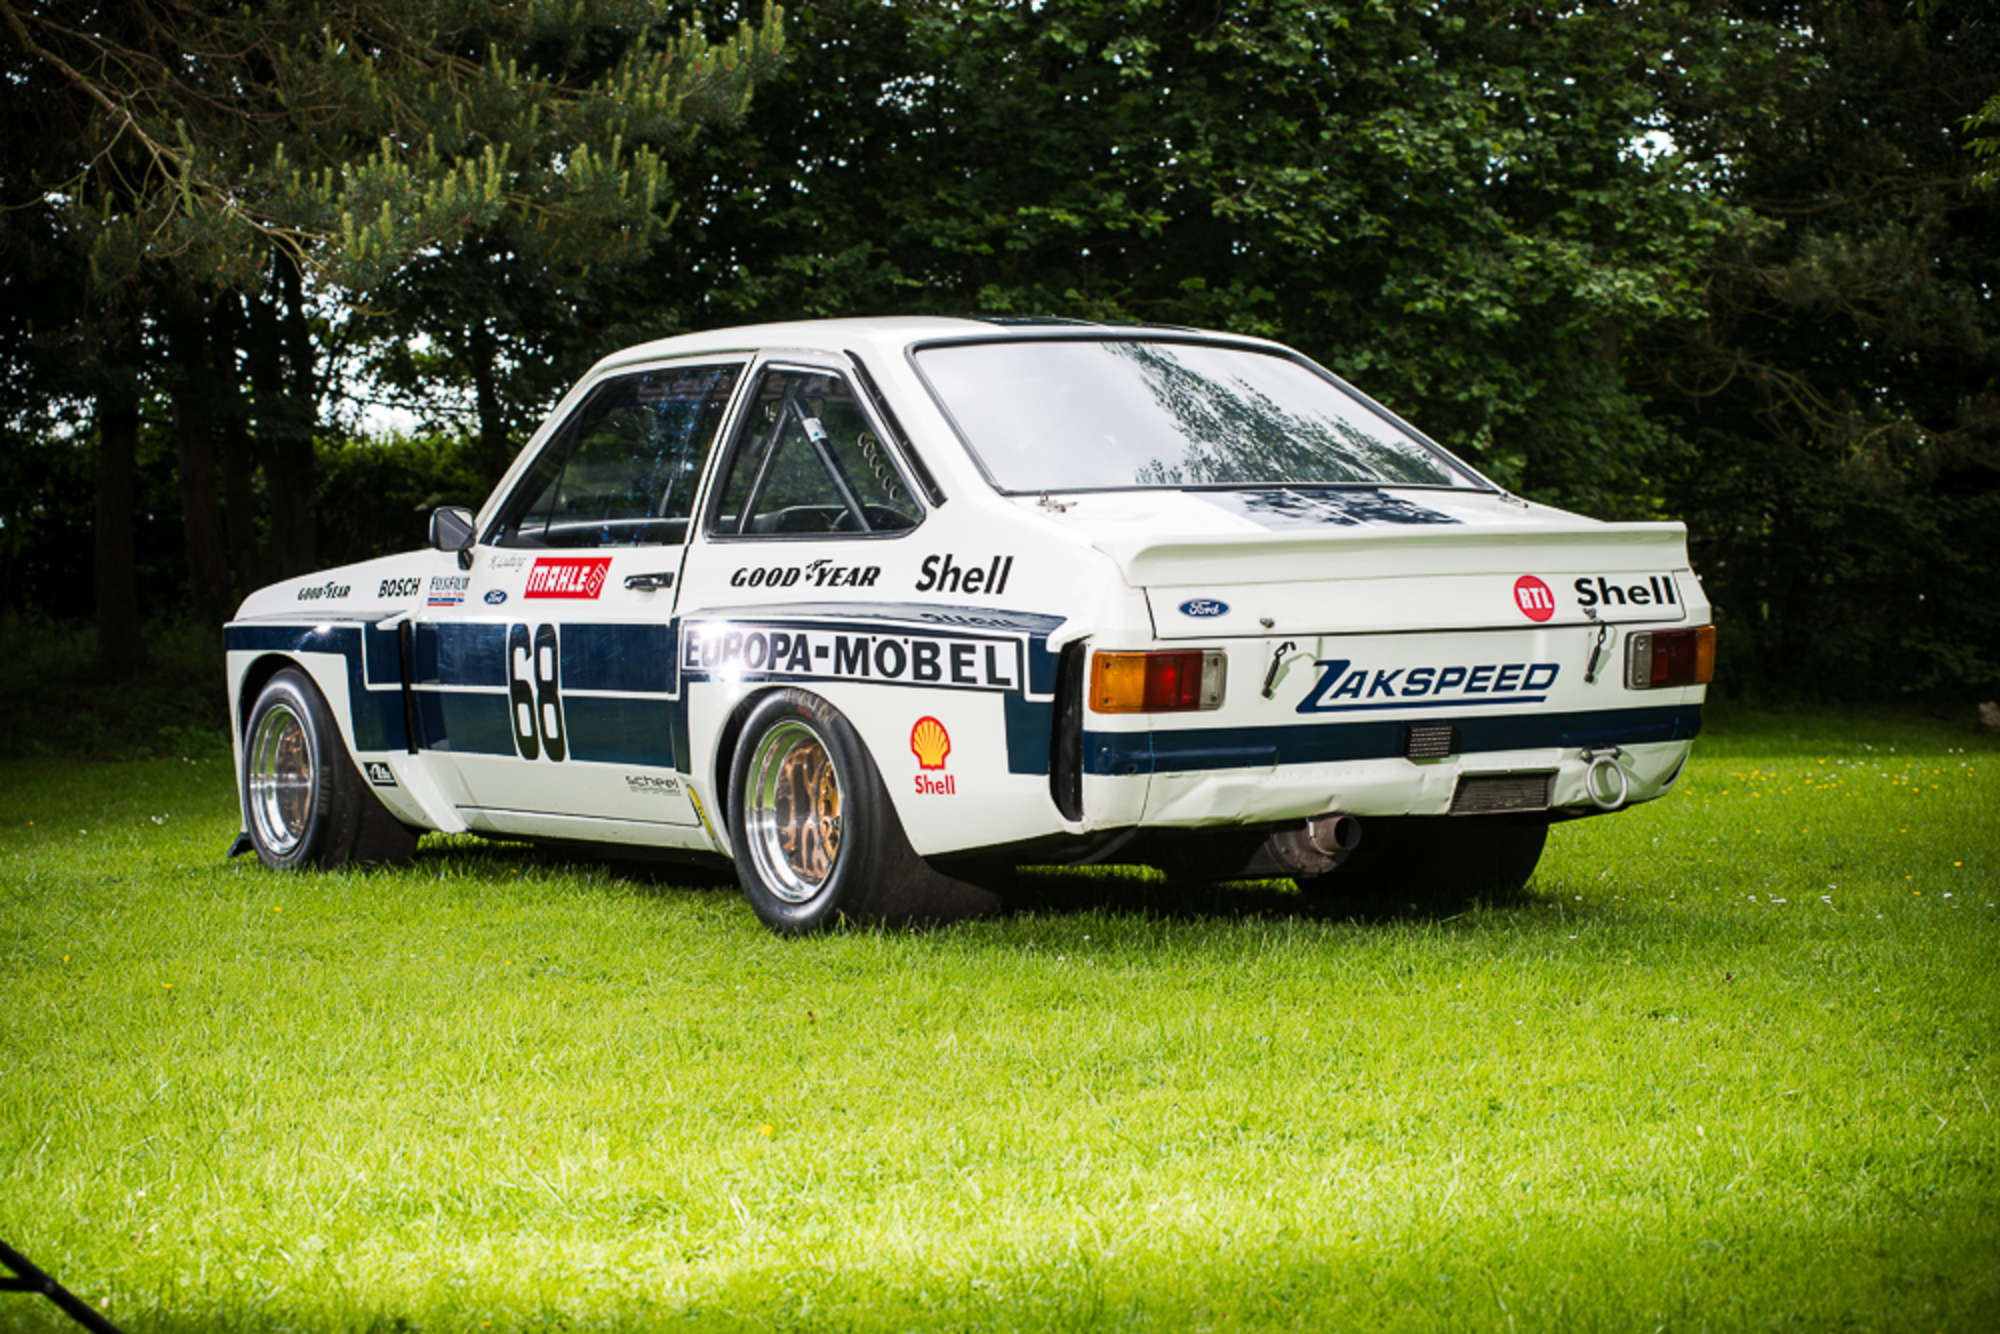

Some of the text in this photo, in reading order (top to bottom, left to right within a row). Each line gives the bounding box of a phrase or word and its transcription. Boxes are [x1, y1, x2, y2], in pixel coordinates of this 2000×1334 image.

[377, 577, 421, 598] BOSCH
[527, 565, 591, 592] MAHLE
[916, 554, 1013, 594] Shell
[1517, 587, 1553, 609] RTL
[1574, 576, 1677, 606] Shell
[1189, 600, 1219, 615] Ford
[509, 623, 566, 762] 68
[1296, 659, 1560, 713] ZAKSPEED
[914, 775, 956, 795] Shell
